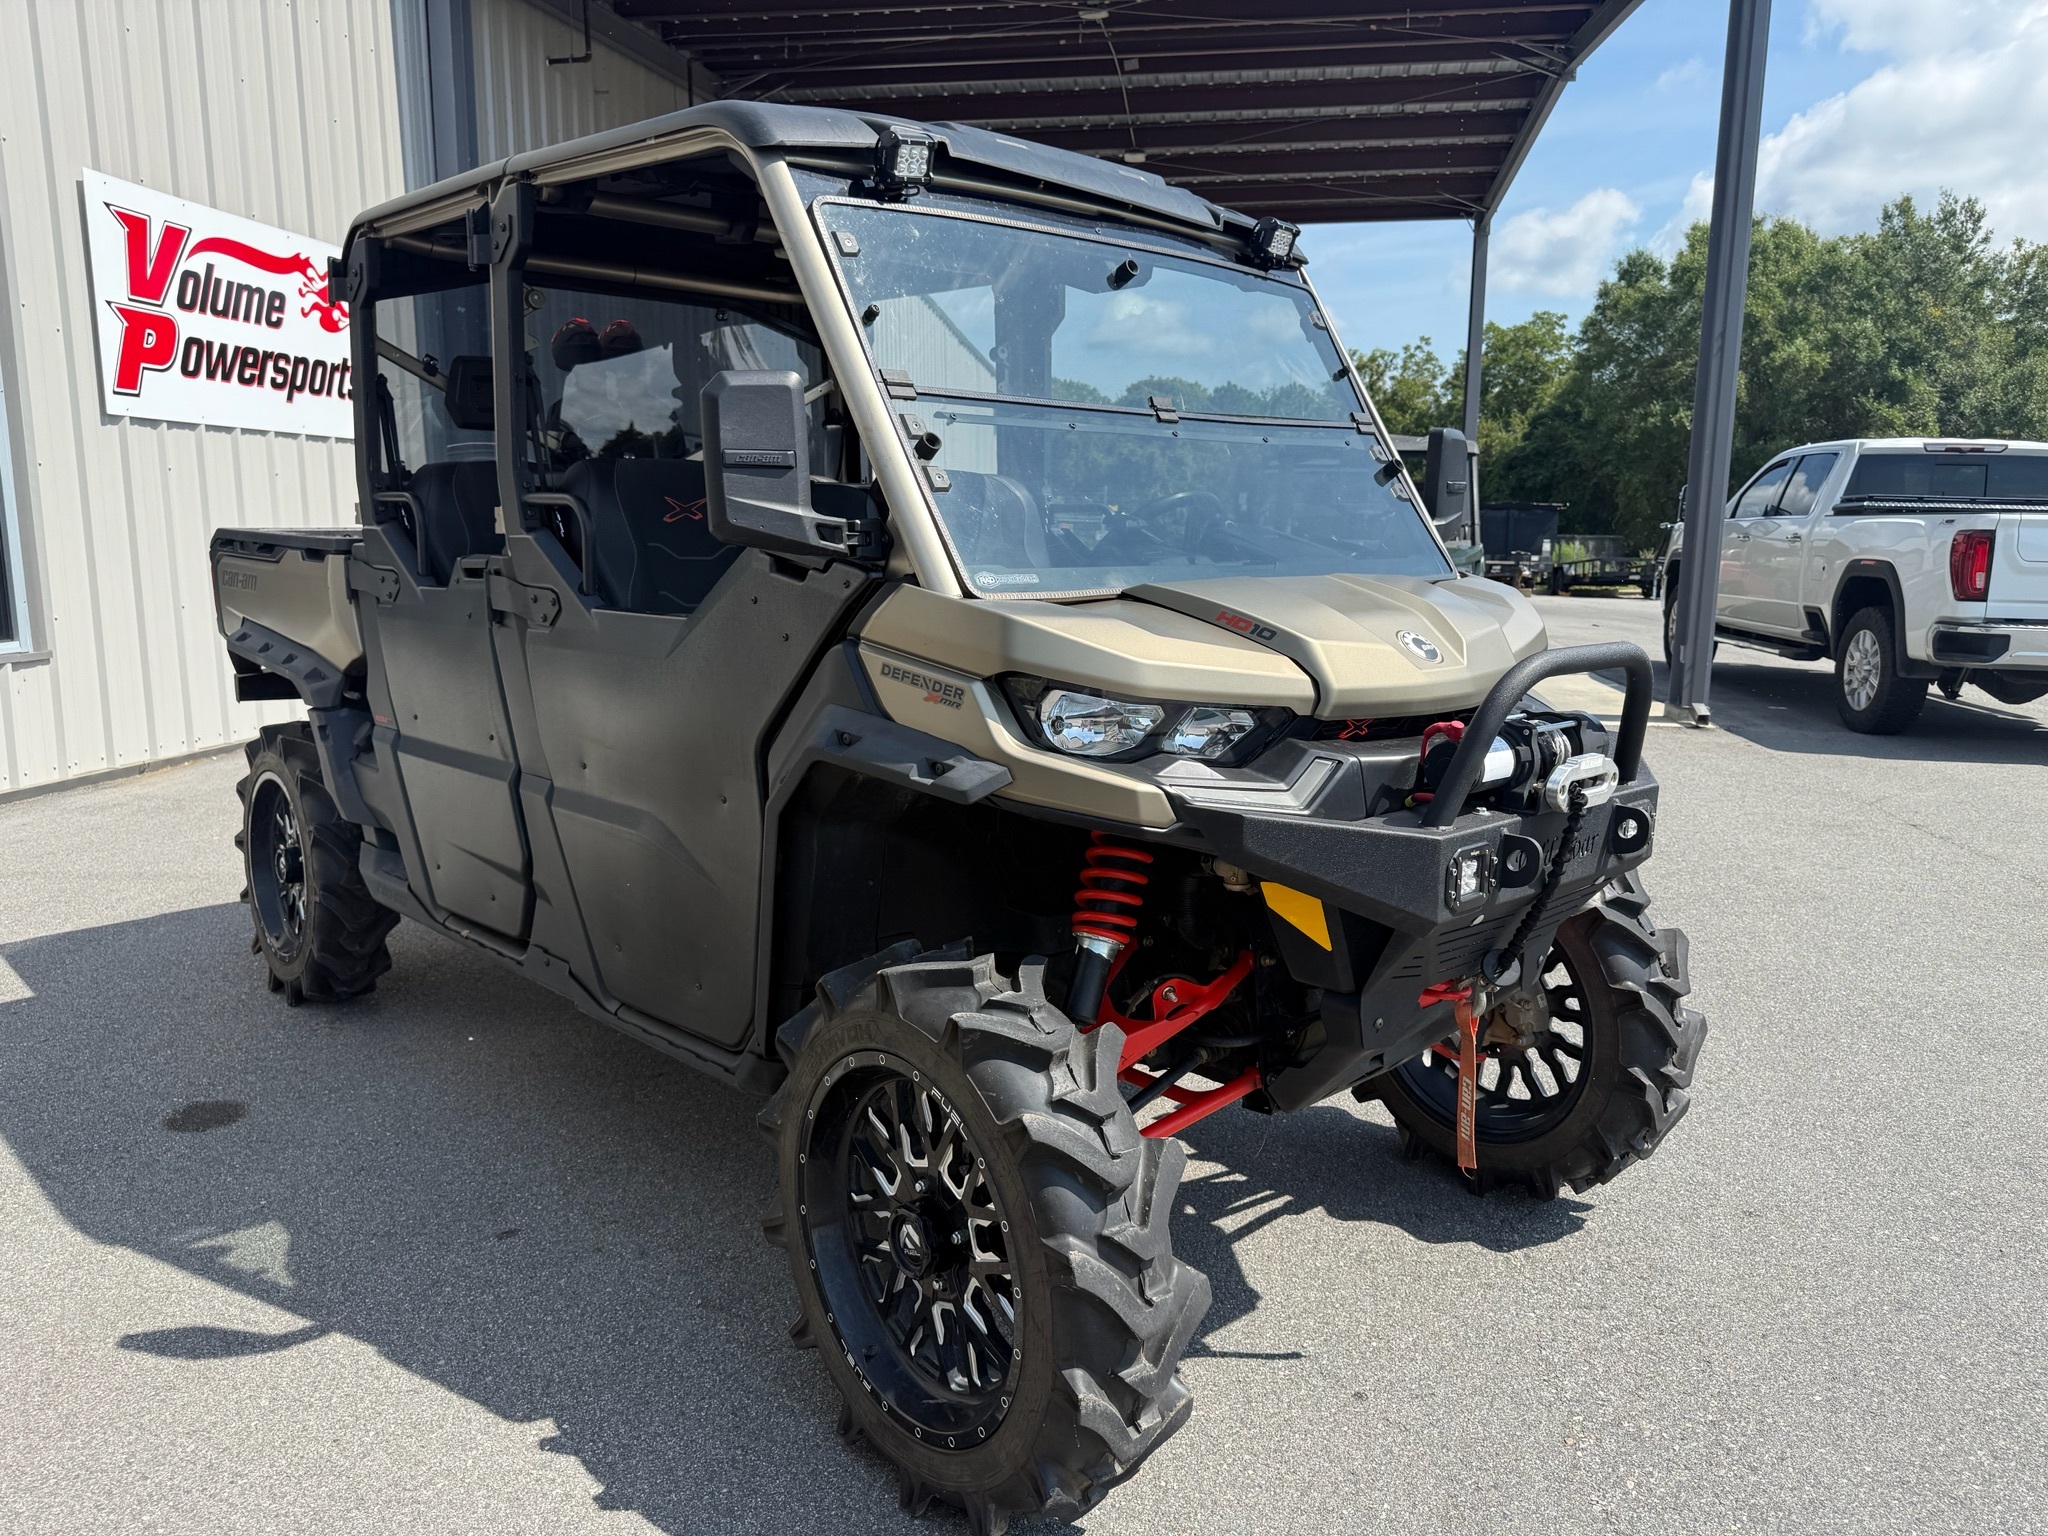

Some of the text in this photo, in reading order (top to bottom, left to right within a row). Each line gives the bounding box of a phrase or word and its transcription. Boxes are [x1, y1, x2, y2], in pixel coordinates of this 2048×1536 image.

[103, 200, 287, 331] Volume
[222, 570, 257, 592] can-am
[1215, 610, 1277, 641] HD10
[881, 663, 965, 701] DEFENDER
[931, 1086, 968, 1140] FUEL
[1460, 1075, 1473, 1142] can-am
[841, 1338, 872, 1392] FUEL
